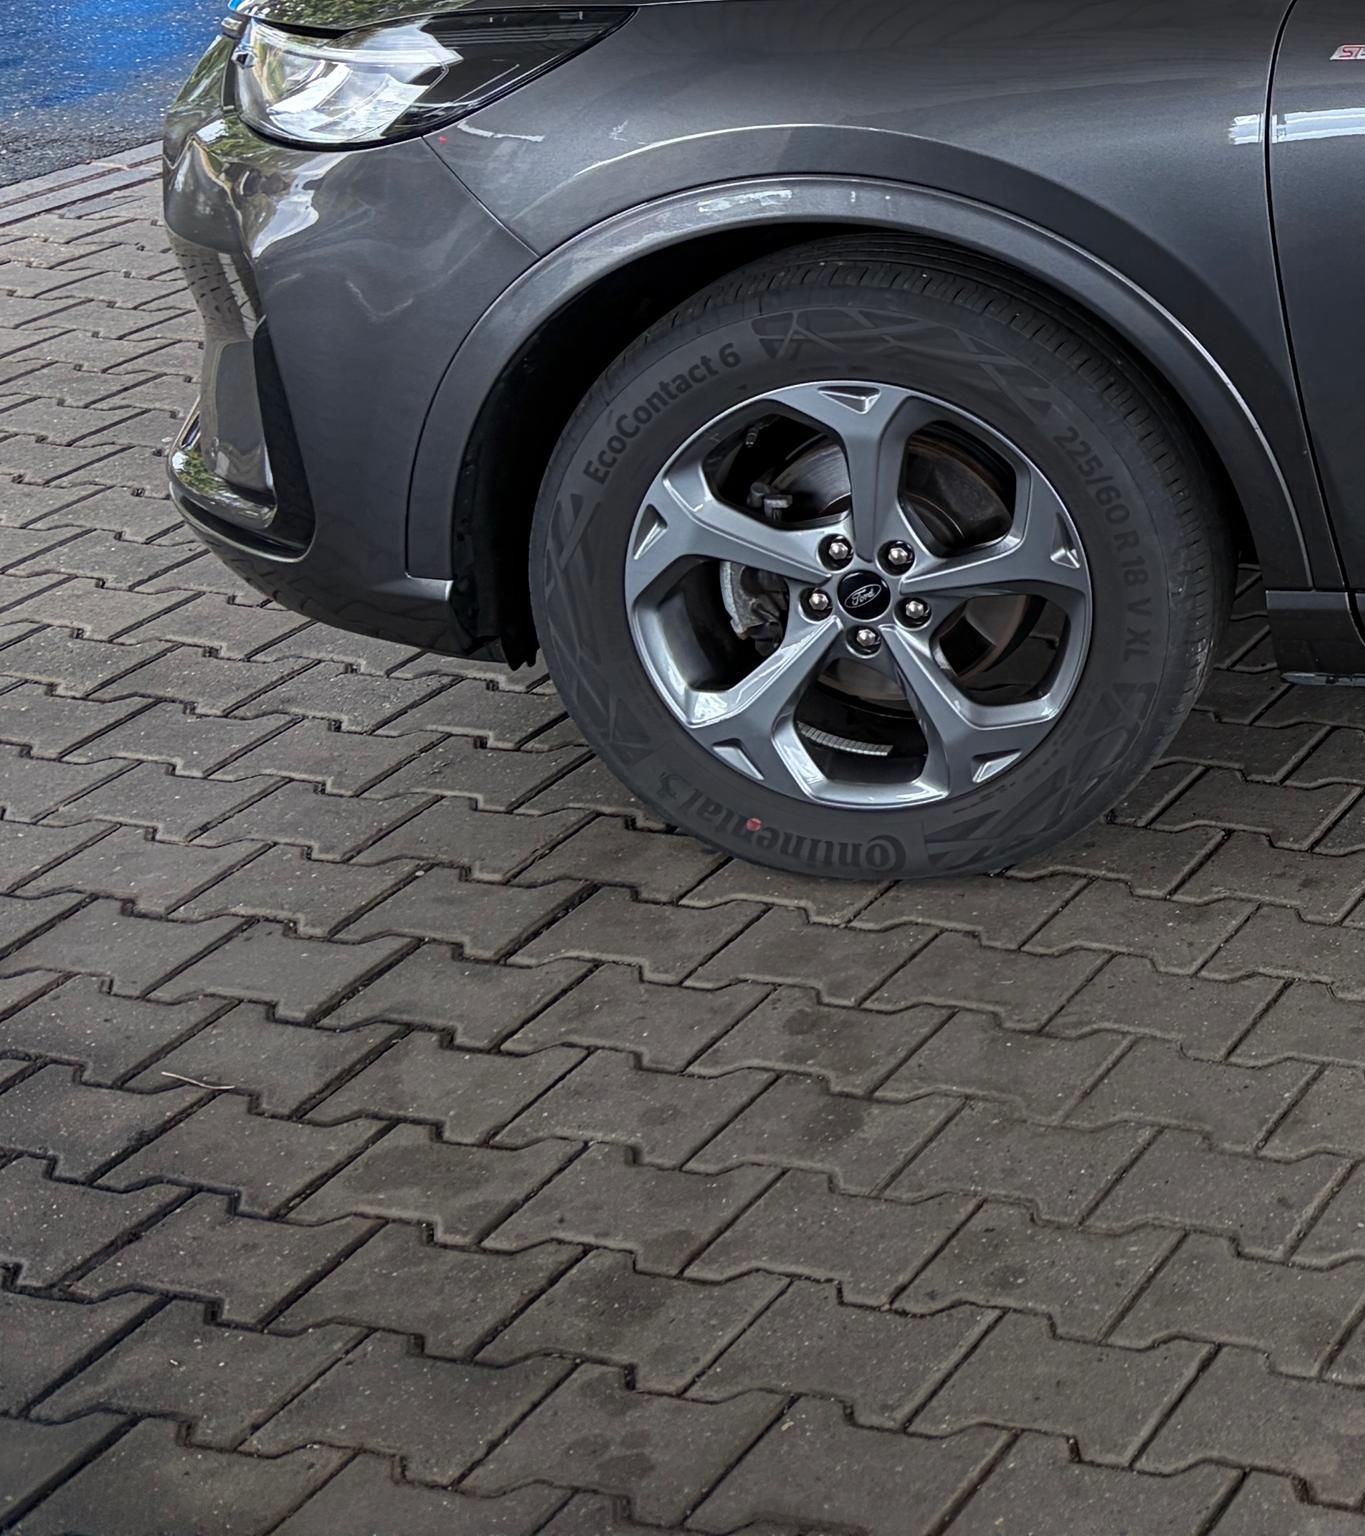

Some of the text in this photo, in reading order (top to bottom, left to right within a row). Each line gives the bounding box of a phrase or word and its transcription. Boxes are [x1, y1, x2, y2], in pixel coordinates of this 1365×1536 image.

[584, 343, 741, 485] EcoContact 6
[848, 585, 877, 606] Ford
[1053, 426, 1152, 663] 225/60 R 18 V XL
[679, 788, 907, 872] Continental
